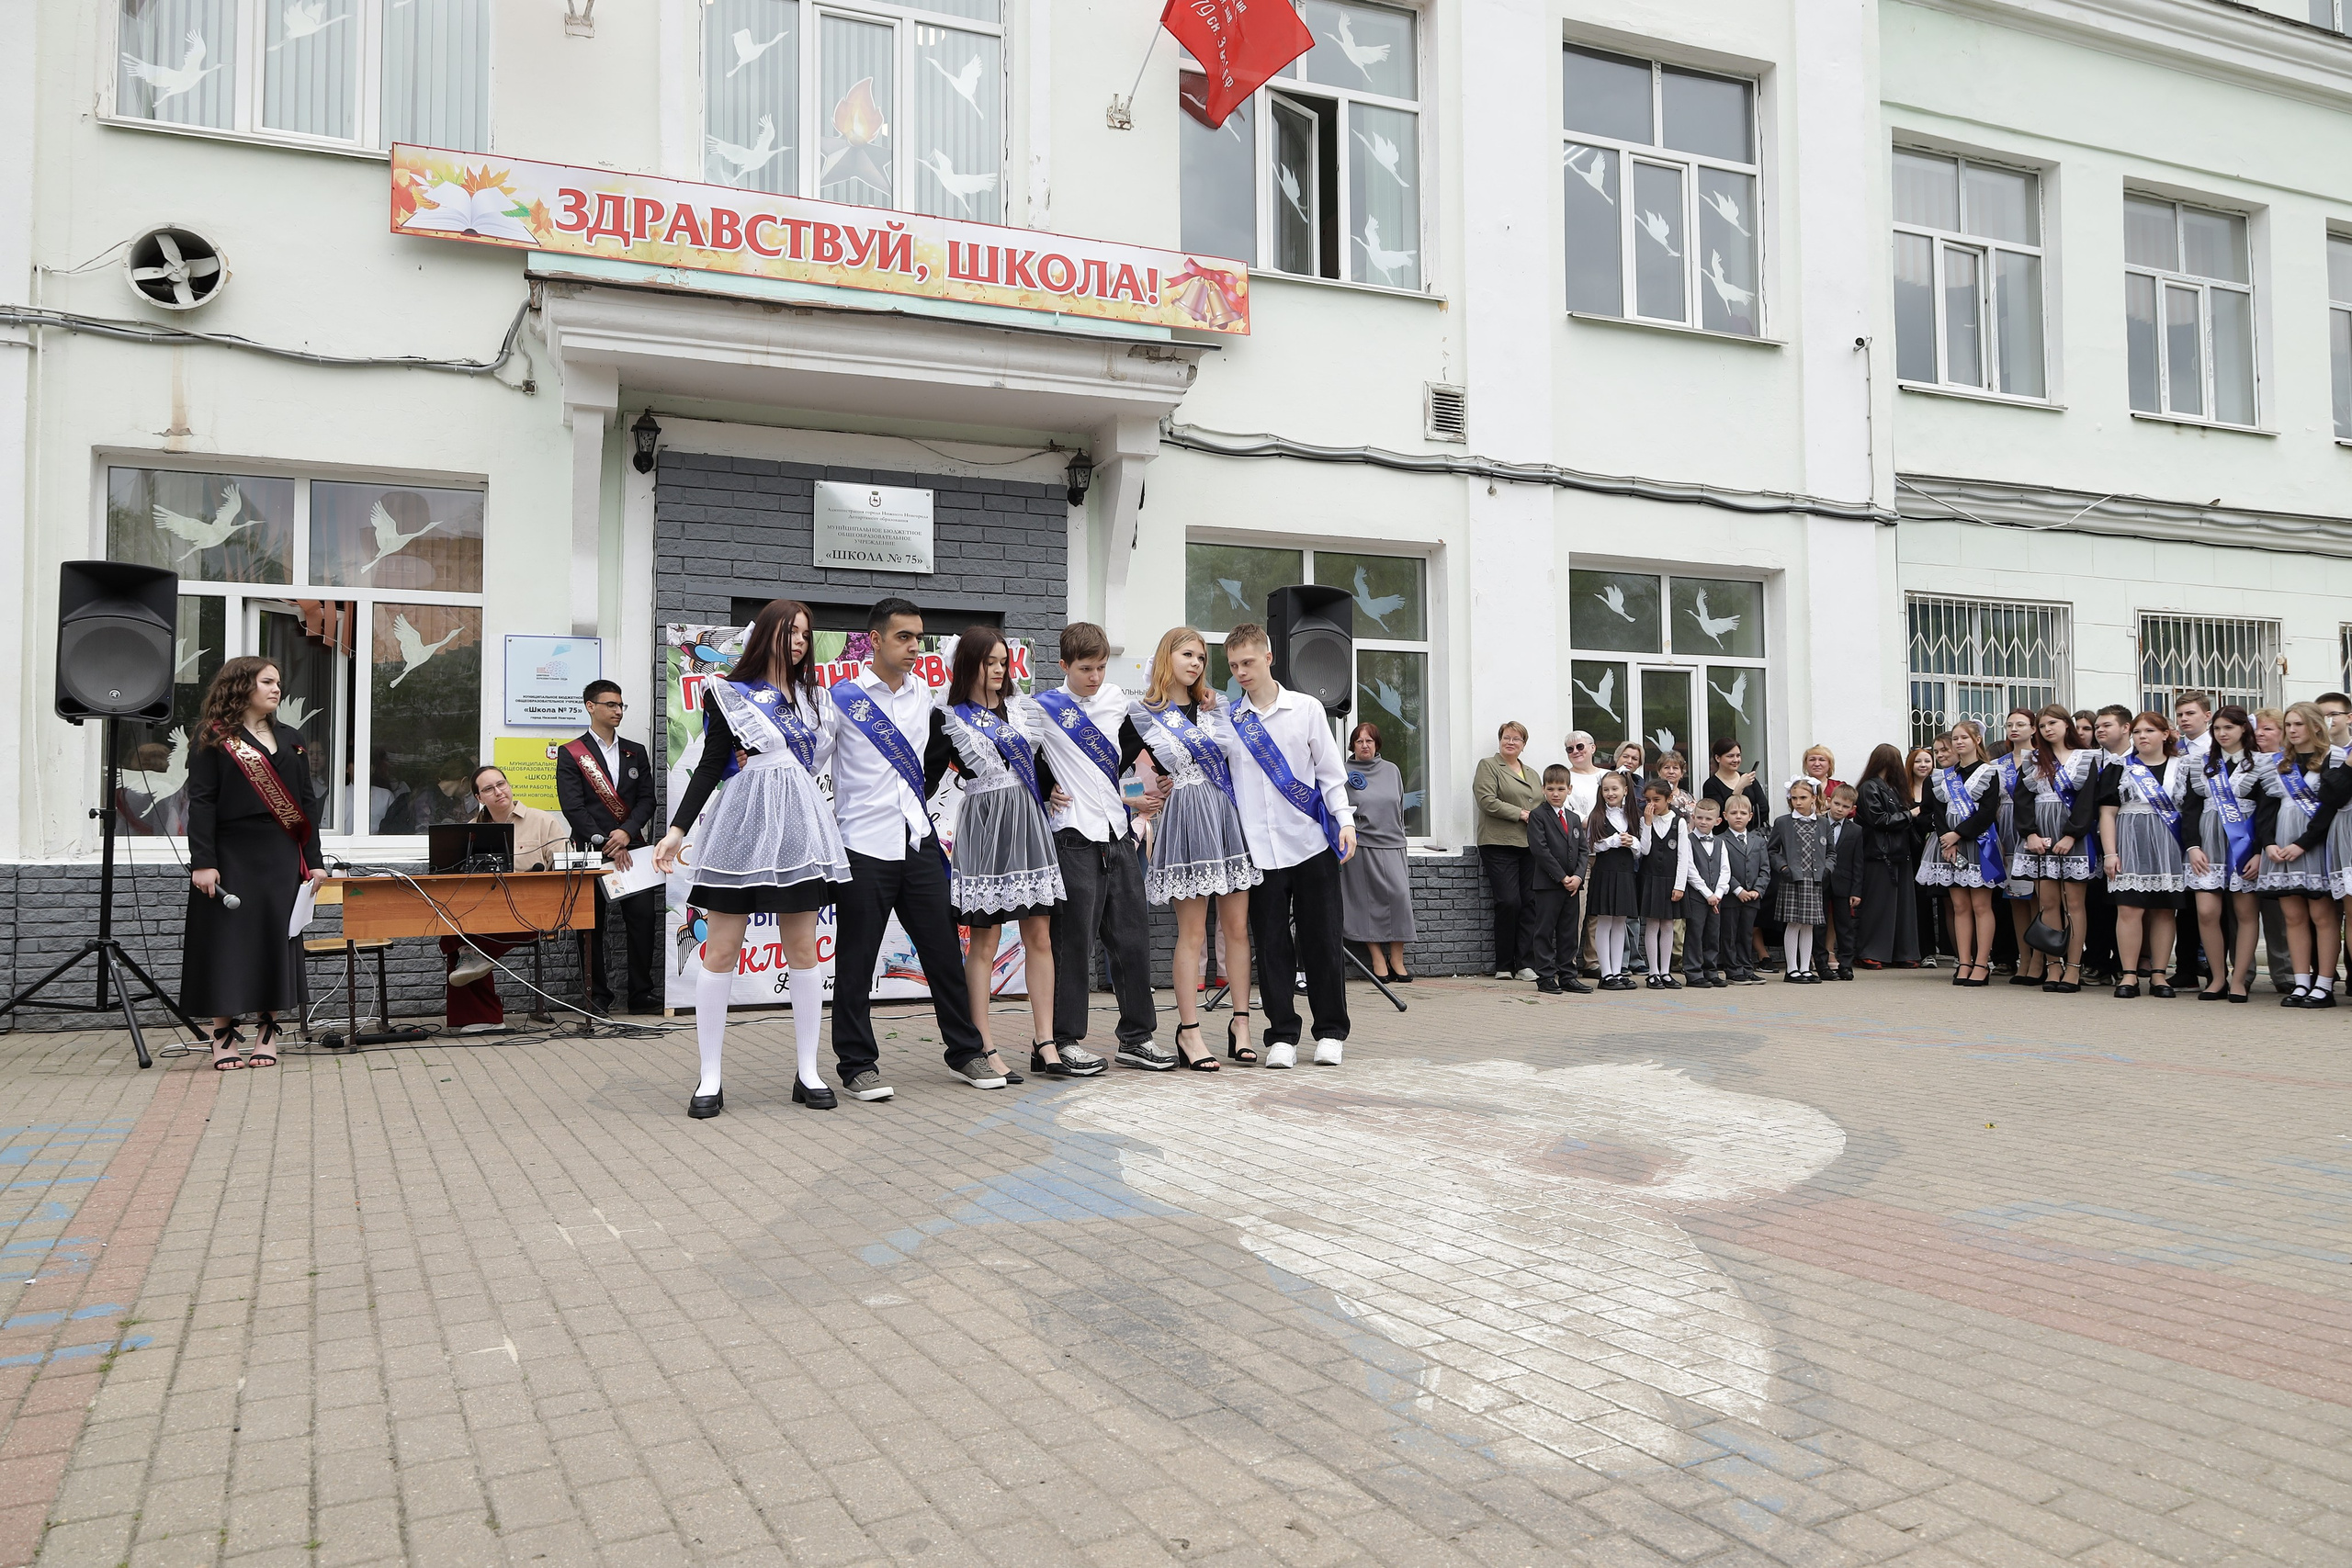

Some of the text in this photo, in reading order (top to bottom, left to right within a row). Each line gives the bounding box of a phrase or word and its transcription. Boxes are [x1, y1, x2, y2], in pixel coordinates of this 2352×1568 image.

[555, 187, 1159, 304] ЗДРАВСТВУЙ, ШКОЛА!
[827, 525, 922, 536] МУНИЦИПАЛЬНОЕ БЮДЖЕТНОЕ
[837, 532, 912, 541] ОБЩЕОБРАЗОВАТЕЛЬНОЕ
[854, 538, 896, 547] УЧРЕЖДЕНИЕ
[826, 550, 923, 564] «ШКОЛА № 75»
[872, 720, 919, 782] Выпускник
[1245, 723, 1284, 782] Выпускник
[1284, 780, 1312, 803] 2025
[2222, 803, 2241, 823] 2025
